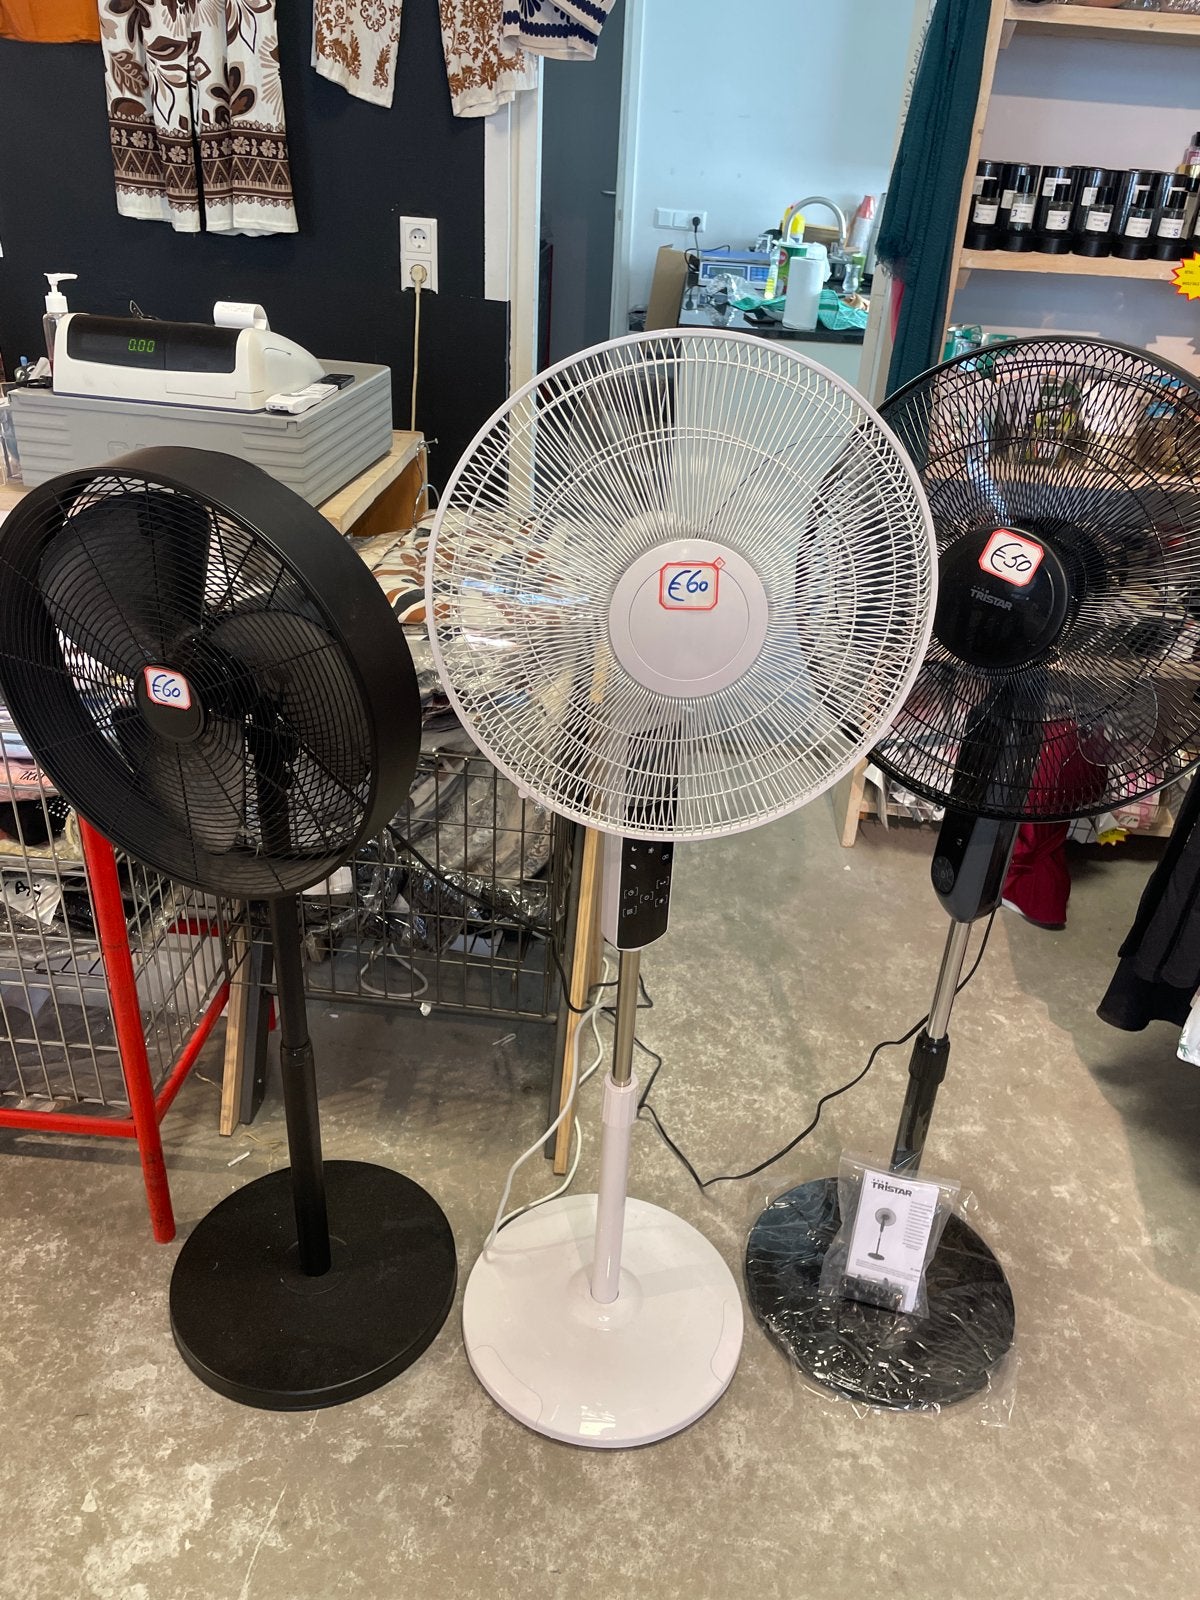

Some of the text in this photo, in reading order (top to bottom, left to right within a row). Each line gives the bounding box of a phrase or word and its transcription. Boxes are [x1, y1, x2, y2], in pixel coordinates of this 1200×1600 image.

[128, 338, 156, 353] 0.00
[990, 543, 1032, 573] €50
[970, 587, 1013, 611] TRISTAR
[872, 1180, 913, 1197] TRISTAR
